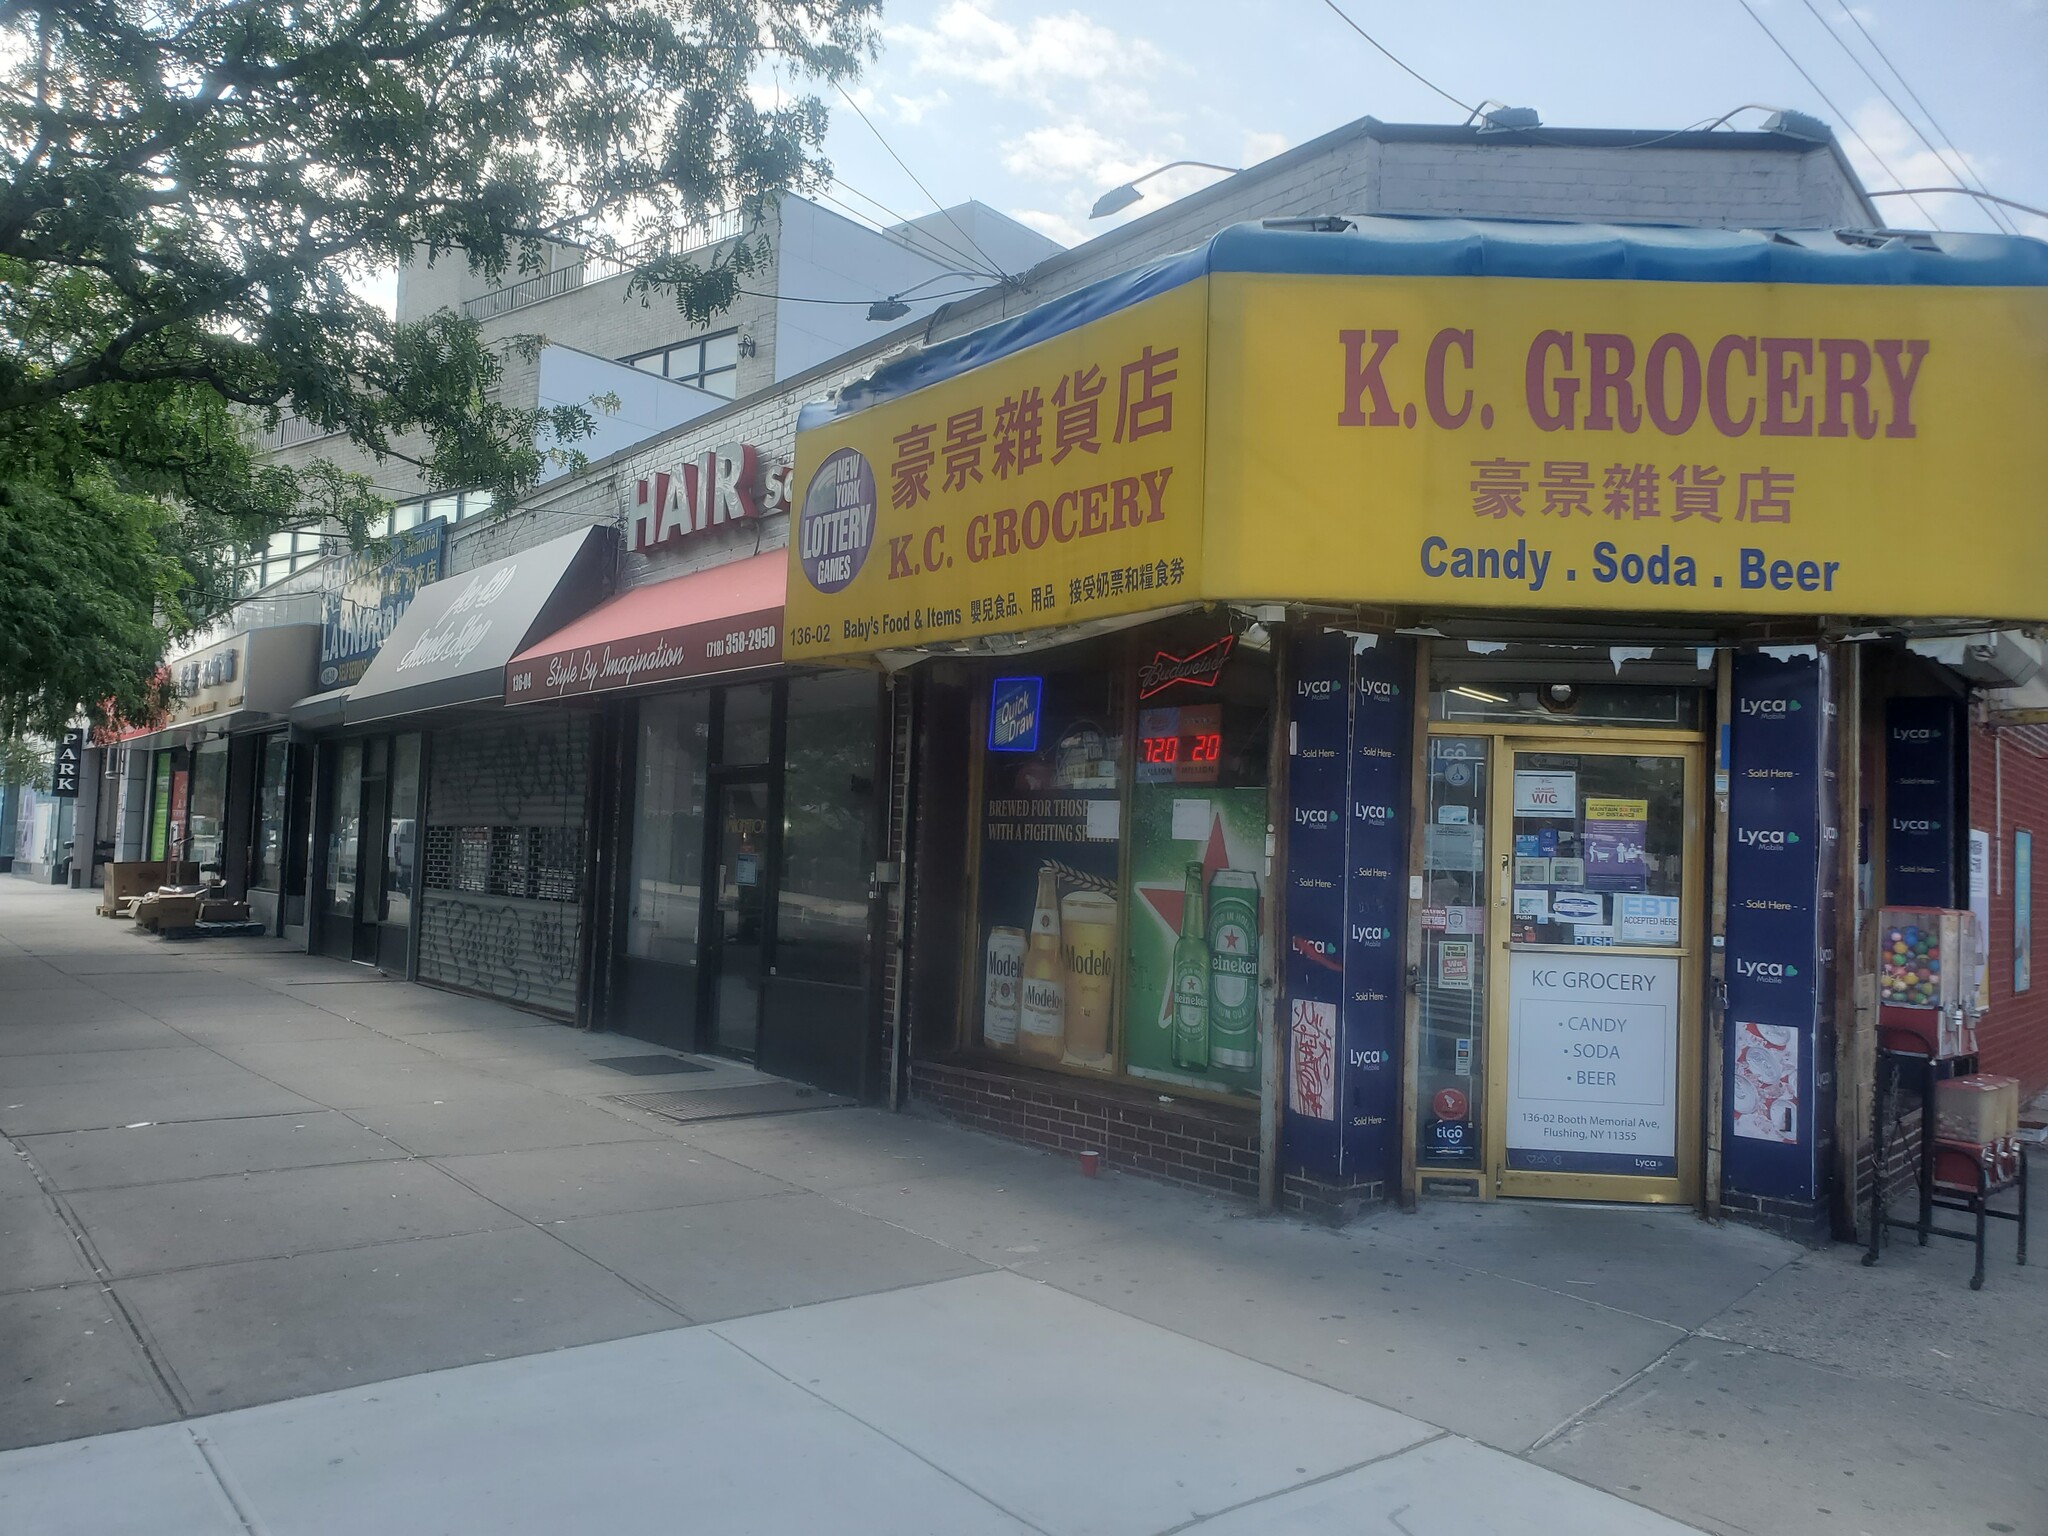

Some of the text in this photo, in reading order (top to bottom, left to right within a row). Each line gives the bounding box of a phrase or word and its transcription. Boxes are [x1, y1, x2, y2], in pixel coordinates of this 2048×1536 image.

[1337, 327, 1930, 440] K.C. GROCERY
[890, 345, 1179, 511] 豪景雜貨店
[835, 453, 860, 485] NEW
[626, 441, 750, 552] HAIR
[835, 481, 861, 509] YORK
[1469, 457, 1796, 524] 豪景雜貨店
[803, 502, 871, 560] LOTTERY
[888, 466, 1174, 580] K.C. GROCERY
[817, 554, 851, 585] GAMES
[1420, 536, 1840, 593] Candy Soda Beer
[790, 606, 962, 646] 136-02 Baby's Food & Items
[511, 672, 532, 692] 136-04
[546, 655, 579, 695] Style
[579, 650, 598, 690] By
[599, 637, 685, 685] Imagination
[725, 626, 776, 655] 358-2950
[1138, 656, 1230, 688] Budweiser
[1298, 680, 1330, 697] Lyca
[1361, 677, 1390, 695] Lyca
[1001, 690, 1029, 724] Quick
[1740, 698, 1786, 715] Lyca
[1008, 711, 1034, 742] Draw
[1893, 727, 1929, 740] Lyca
[1192, 734, 1220, 761] 20
[1302, 750, 1317, 758] Sold
[1363, 748, 1392, 758] Sold Here
[57, 733, 78, 790] PARK
[1747, 769, 1793, 778] Sold Here
[1531, 793, 1558, 804] WIC
[989, 800, 1030, 816] BREWED
[1032, 800, 1051, 816] FOR
[1295, 808, 1327, 824] Lyca
[1355, 802, 1385, 820] Lyca
[988, 824, 1013, 840] WITH
[1015, 824, 1021, 840] A
[1024, 824, 1073, 841] FIGHTING
[1893, 818, 1929, 831] Lyca
[1738, 827, 1784, 847] Lyca
[1359, 868, 1387, 877] Sold Here
[1299, 879, 1331, 888] Sold Here
[1624, 897, 1678, 916] EBT
[1746, 899, 1791, 910] Sold Here
[1624, 916, 1678, 926] ACCEPTED HERE
[1352, 924, 1382, 942] Lyca
[1574, 936, 1614, 946] PUSH
[1212, 957, 1258, 974] eineken
[1444, 965, 1467, 974] Card
[1736, 958, 1783, 978] Lyca
[1532, 970, 1656, 991] KC GROCERY
[1028, 985, 1059, 1009] Modelo
[1174, 992, 1208, 1006] Heineken
[1355, 992, 1384, 1000] Sold Here
[1567, 1016, 1627, 1033] CANDY
[1350, 1049, 1380, 1066] Lyca
[1573, 1043, 1620, 1059] SODA
[1576, 1071, 1616, 1086] BEER
[1353, 1116, 1382, 1126] Sold Here
[1522, 1113, 1660, 1129] 136-02 Booth Memorial Ave,
[1543, 1127, 1636, 1141] Flushing, NY 11355
[1635, 1158, 1656, 1168] Lyca
